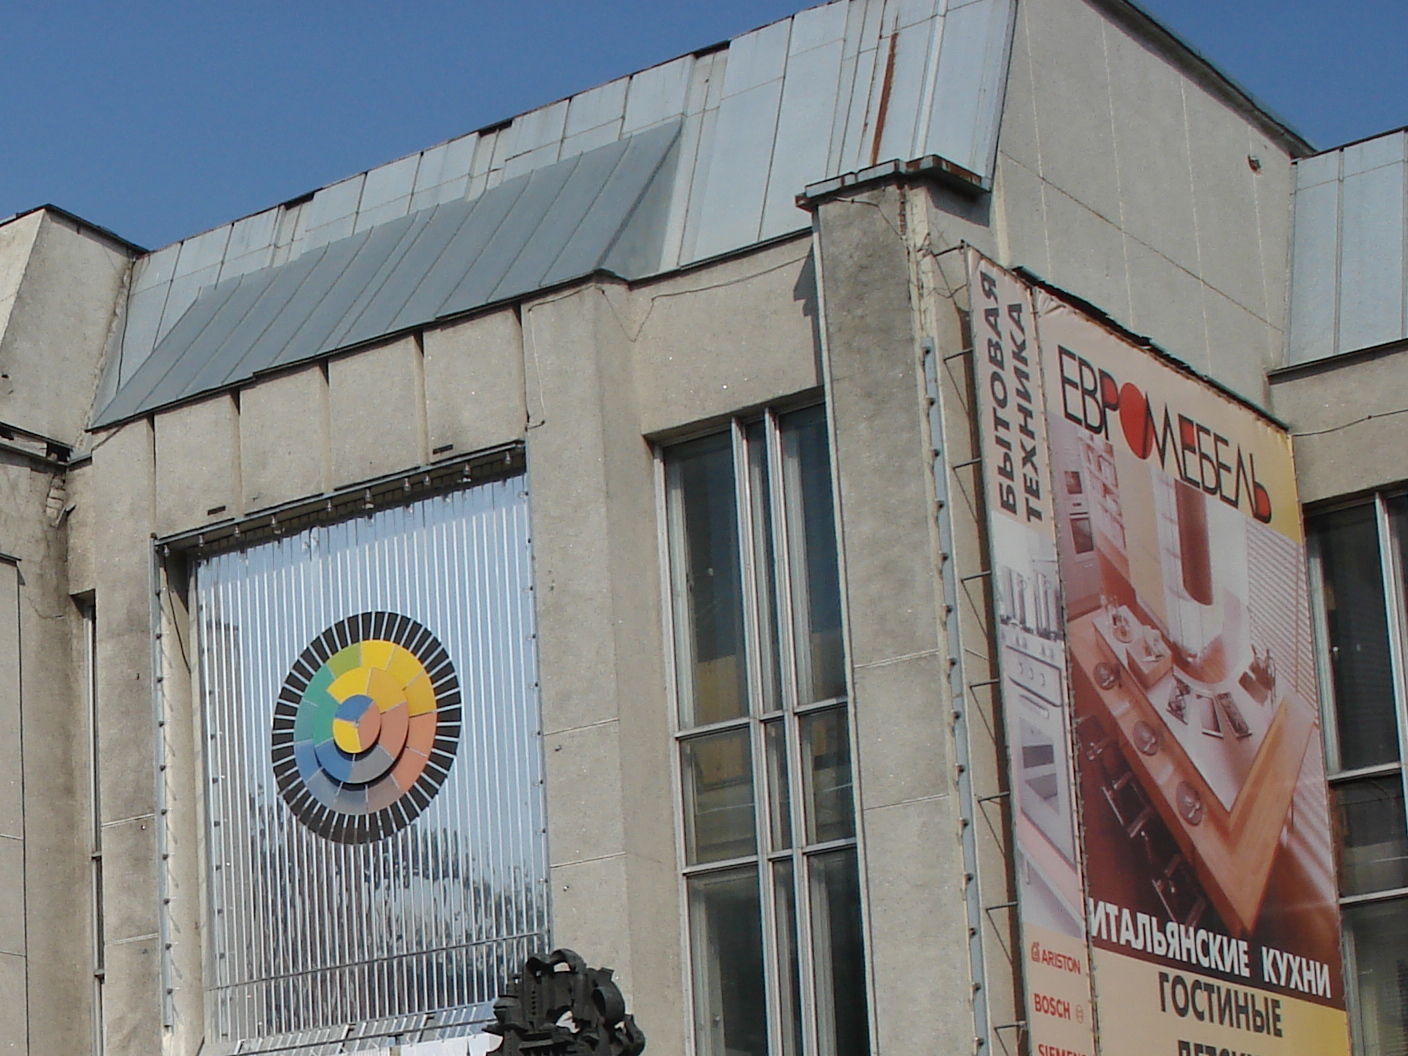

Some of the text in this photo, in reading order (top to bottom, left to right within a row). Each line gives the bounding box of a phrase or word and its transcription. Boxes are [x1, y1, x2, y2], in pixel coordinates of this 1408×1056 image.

[980, 270, 1018, 516] БЫТОВАЯ
[1007, 303, 1043, 523] ТЕХНИКА
[1058, 344, 1272, 524] ЕВРОМЕБЕЛЬ
[1042, 948, 1081, 975] ARISTON
[1090, 897, 1332, 999] ИТАЛЬЯНСКИЕ КУХНИ
[1034, 992, 1071, 1020] BOSCH
[1158, 971, 1283, 1038] ГОСТИНЫЕ
